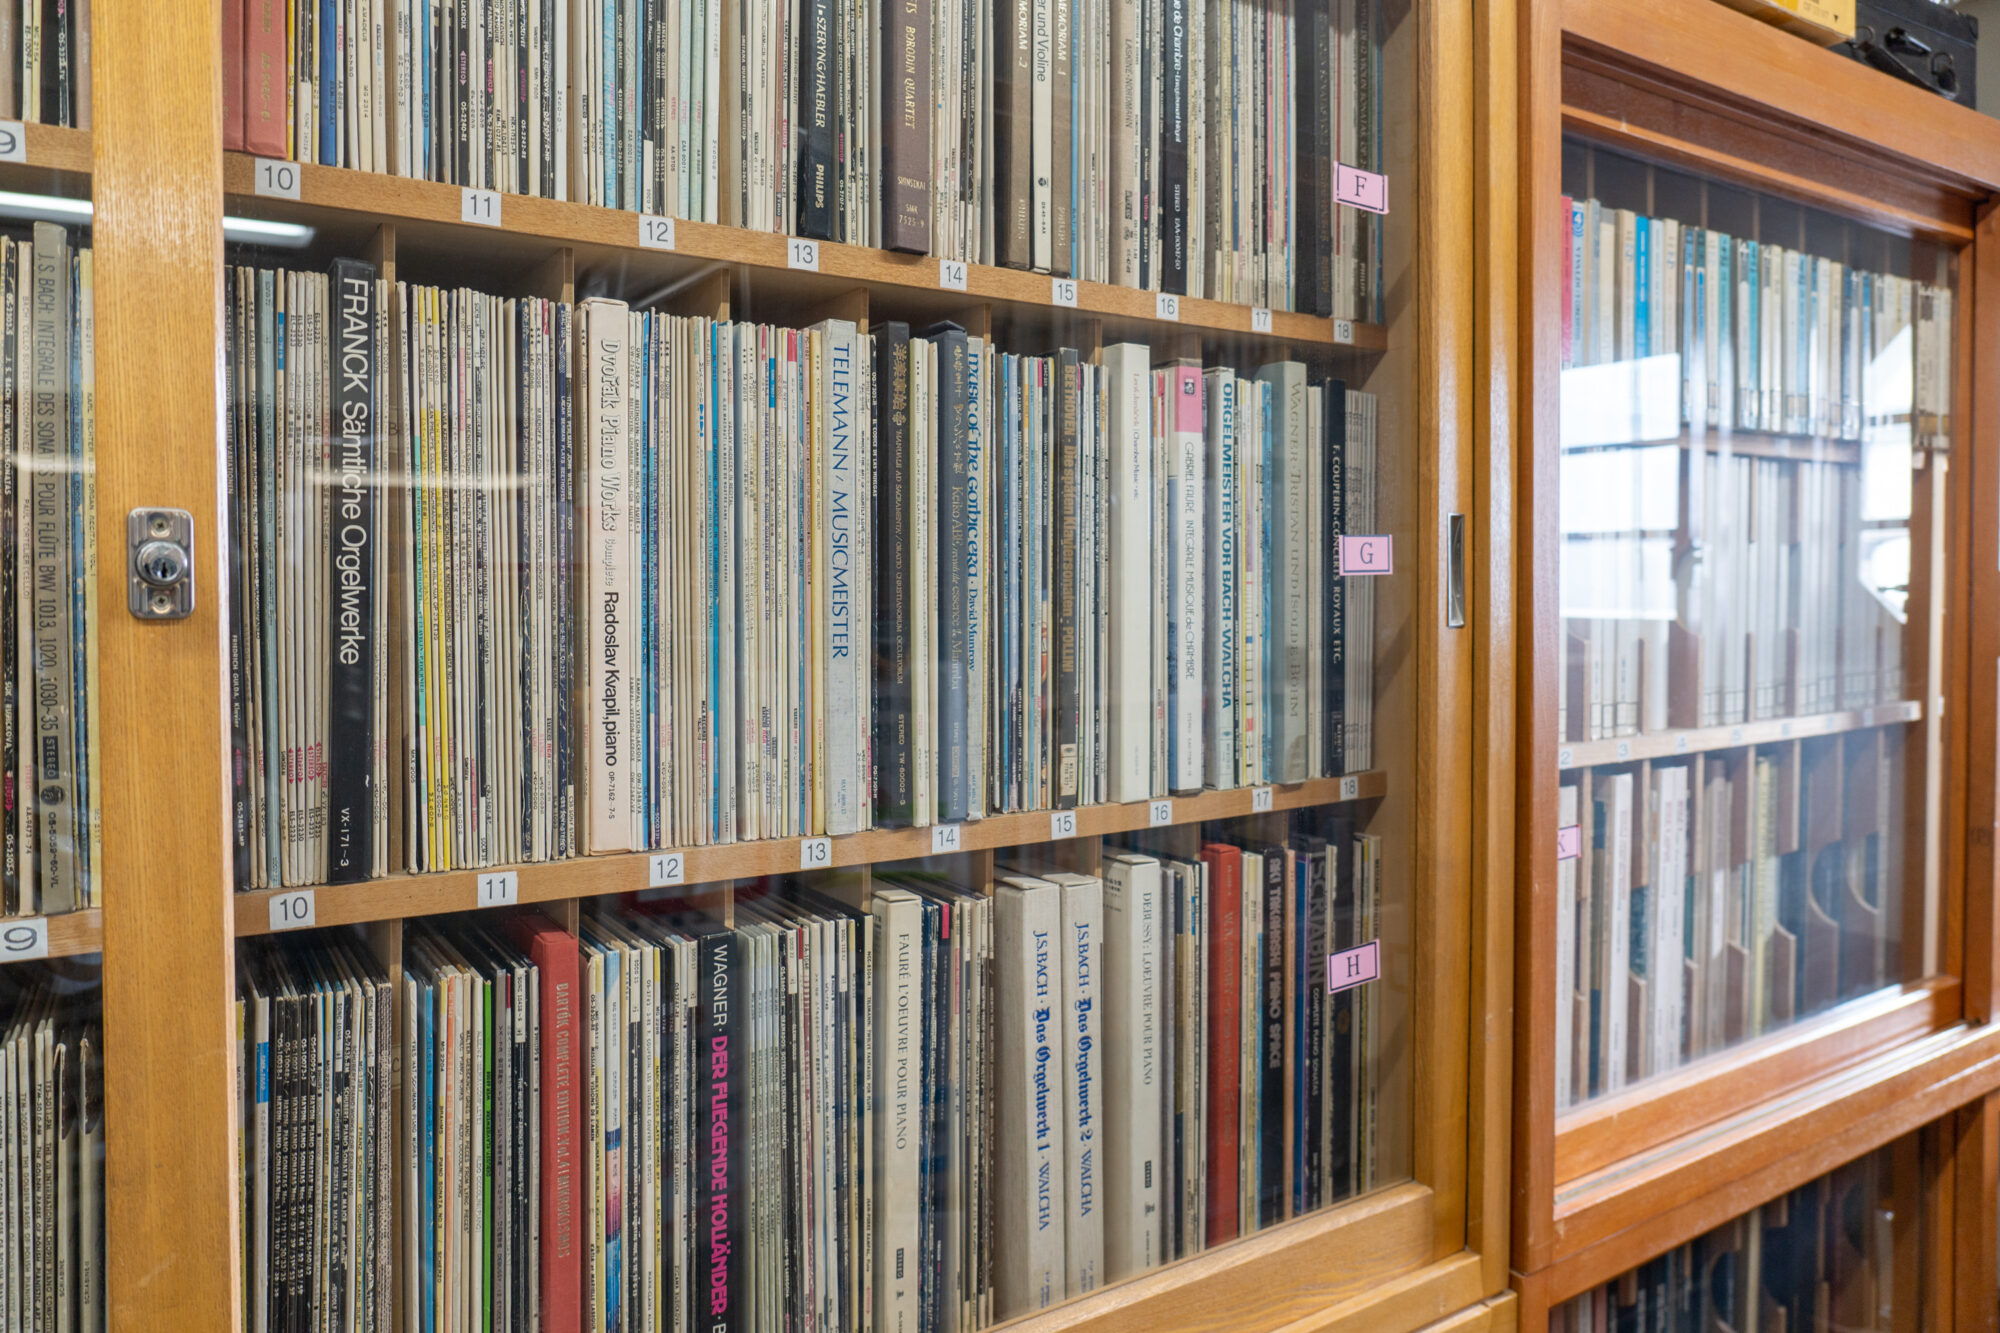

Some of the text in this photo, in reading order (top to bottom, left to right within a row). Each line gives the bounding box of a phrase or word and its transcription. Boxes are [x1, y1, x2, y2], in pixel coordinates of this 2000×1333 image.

[1173, 10, 1182, 24] de
[1037, 15, 1048, 82] und Violine
[904, 26, 915, 129] BORODIN QUARTET
[1124, 39, 1133, 128] LASKINE-NORDMANN
[264, 166, 294, 189] 10
[815, 164, 825, 208] PHILIPS
[1354, 175, 1366, 197] F
[470, 195, 492, 218] 11
[646, 221, 668, 243] 12
[794, 245, 813, 264] 13
[946, 266, 962, 284] 14
[1058, 284, 1073, 301] 15
[37, 279, 54, 314] BACH:
[1161, 298, 1174, 314] 16
[342, 278, 368, 393] FRANCK
[1255, 312, 1268, 326] 17
[1337, 324, 1349, 338] 18
[37, 320, 57, 385] INTÉGRALE
[600, 338, 621, 409] Dvořák
[37, 392, 55, 416] DES
[832, 342, 850, 471] TELEMANN
[1290, 382, 1301, 462] WAGNER
[341, 401, 368, 519] Sämtliche
[600, 415, 621, 469] Piano
[1332, 445, 1340, 454] F.
[895, 471, 903, 482] AD
[1185, 442, 1194, 483] GABRIEL
[38, 483, 55, 517] POUR
[601, 472, 621, 531] Works
[952, 486, 963, 518] Keiko
[1185, 485, 1195, 514] FAURÉ
[1332, 457, 1340, 515] COUPERIN
[1062, 365, 1076, 672] BEETHOVEN Die späten Klaviersonaten POLLINI
[1290, 472, 1302, 542] TRISTAN
[38, 522, 58, 559] FLÛTE
[1222, 383, 1232, 709] ORGELMEISTER VOR BACH WALCHA
[1359, 542, 1373, 565] G
[39, 565, 56, 592] BWV
[601, 538, 616, 586] Complete
[831, 490, 849, 659] MUSICMEISTER
[1290, 549, 1300, 589] UND
[336, 525, 366, 664] Orgelwerke
[968, 589, 978, 621] David
[1185, 572, 1195, 615] MUSIQUE
[1333, 587, 1341, 634] ROYAUX
[604, 592, 619, 666] Radoslav
[1186, 617, 1194, 630] de
[1290, 593, 1300, 656] ISOLDE
[968, 623, 978, 671] Munrow
[1185, 631, 1195, 680] CHAMBRE
[1333, 640, 1341, 664] ETC.
[46, 739, 56, 777] STEREO
[1256, 791, 1269, 807] 17
[1344, 781, 1355, 795] 18
[1057, 816, 1072, 833] 15
[1155, 805, 1168, 821] 16
[807, 842, 826, 862] 13
[938, 829, 955, 846] 14
[657, 858, 678, 879] 12
[486, 878, 507, 899] 11
[279, 898, 309, 921] 10
[1142, 892, 1152, 950] DEBUSSY:
[1270, 887, 1281, 968] TAKAHASHI
[1310, 862, 1325, 985] SCRIABIN
[3, 926, 38, 952] 9
[1346, 954, 1360, 977] H
[556, 983, 571, 1028] BARTÓK
[1270, 972, 1281, 1019] PIANO
[896, 934, 911, 1150] FAURÉ L'OEUVRE POUR PIANO
[1143, 1013, 1152, 1044] POUR
[1269, 1023, 1281, 1069] SPACE
[556, 1030, 569, 1088] COMPLETE
[1074, 922, 1093, 1218] J.S.BACH Das Orgelwerk 2 WALCHA
[1143, 1048, 1152, 1085] PIANO
[1033, 930, 1051, 1231] J.S.BACH Das Orgelwerk 1 WALCHA
[711, 944, 731, 1316] WAGNER DER FLIEGENDE HOLLÄNDER
